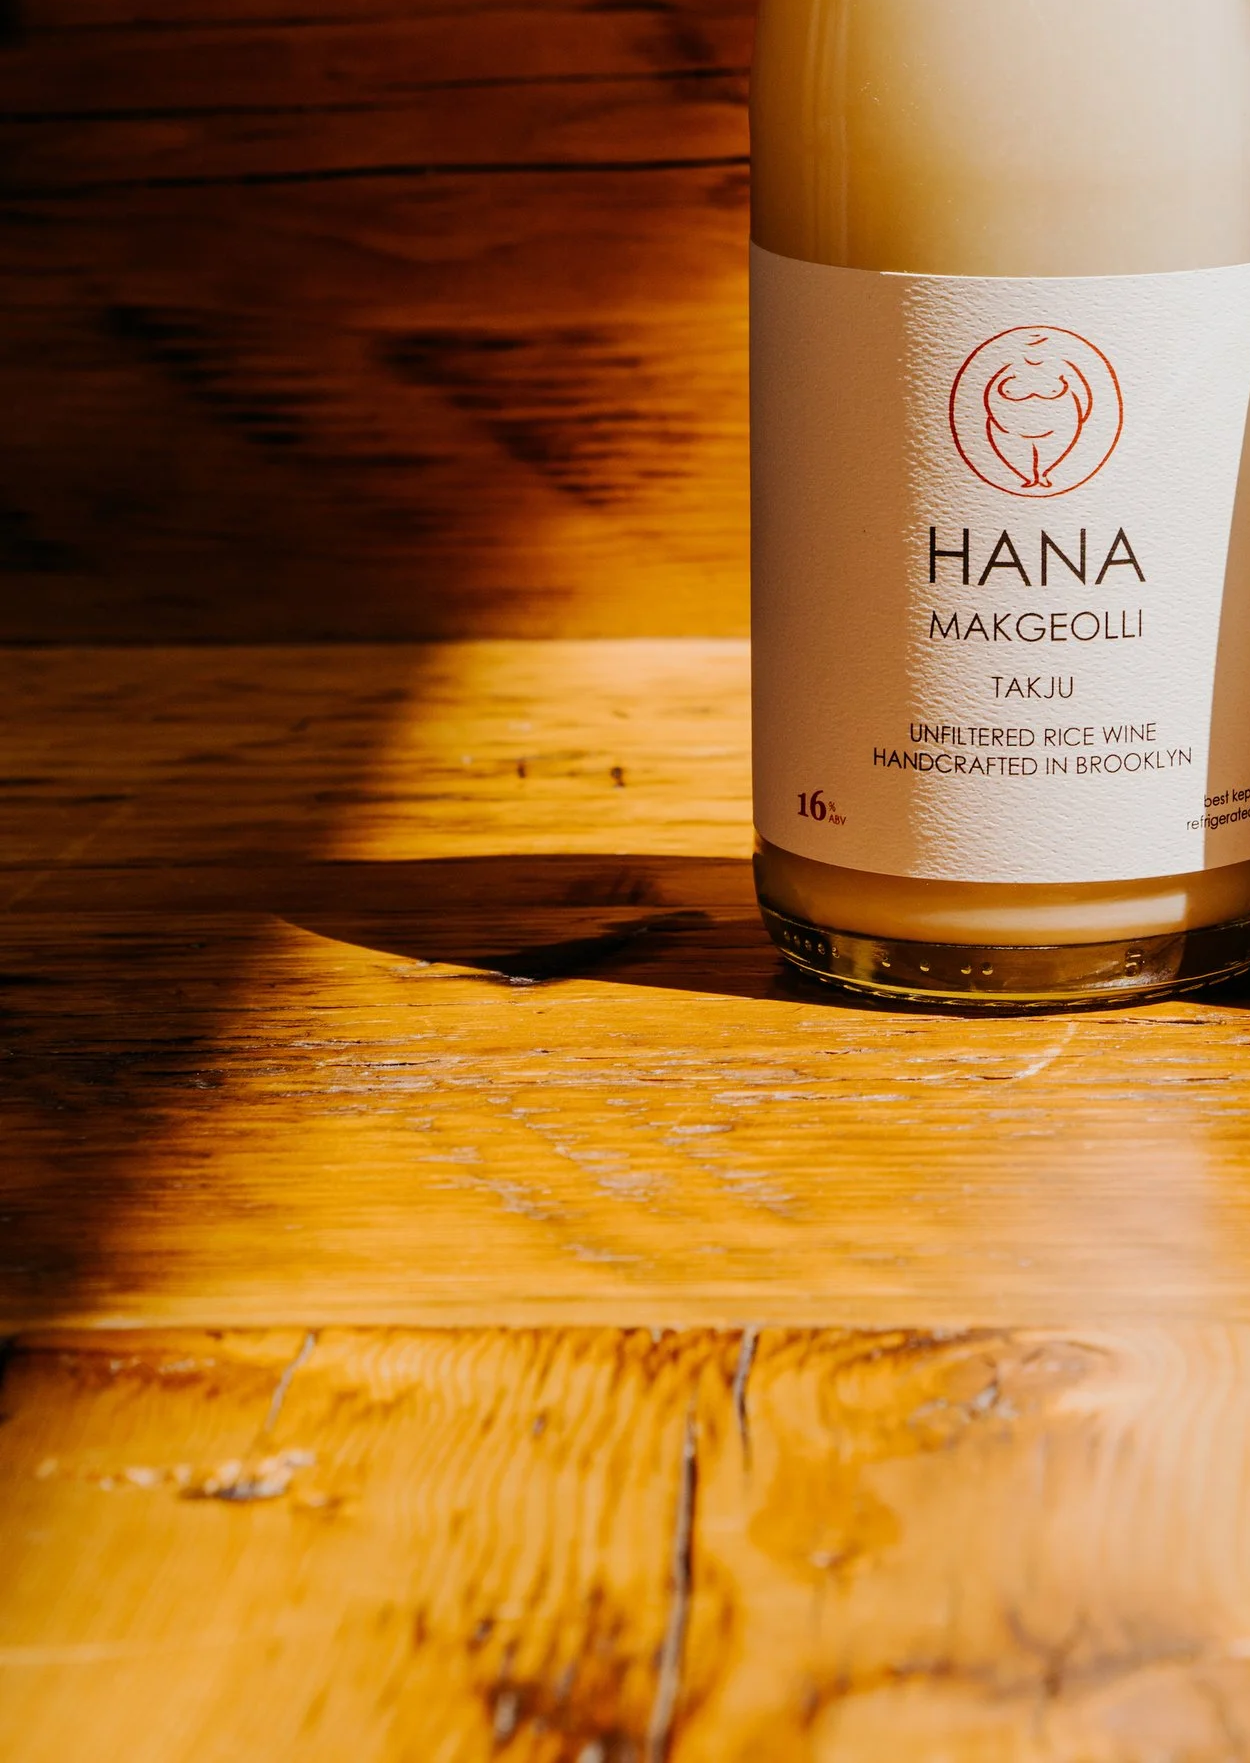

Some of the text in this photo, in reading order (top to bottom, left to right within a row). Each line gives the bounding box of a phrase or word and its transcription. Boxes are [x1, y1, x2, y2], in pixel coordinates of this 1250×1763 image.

[929, 526, 1146, 587] HANA
[929, 609, 1143, 642] MAKGEOLLI
[991, 676, 1074, 699] TAKJU
[910, 723, 1157, 747] UNFILTERED RICE WINE
[873, 747, 1193, 776] HANDCRAFTED IN BROOKLYN
[1204, 790, 1230, 808] best
[828, 814, 847, 826] ABV
